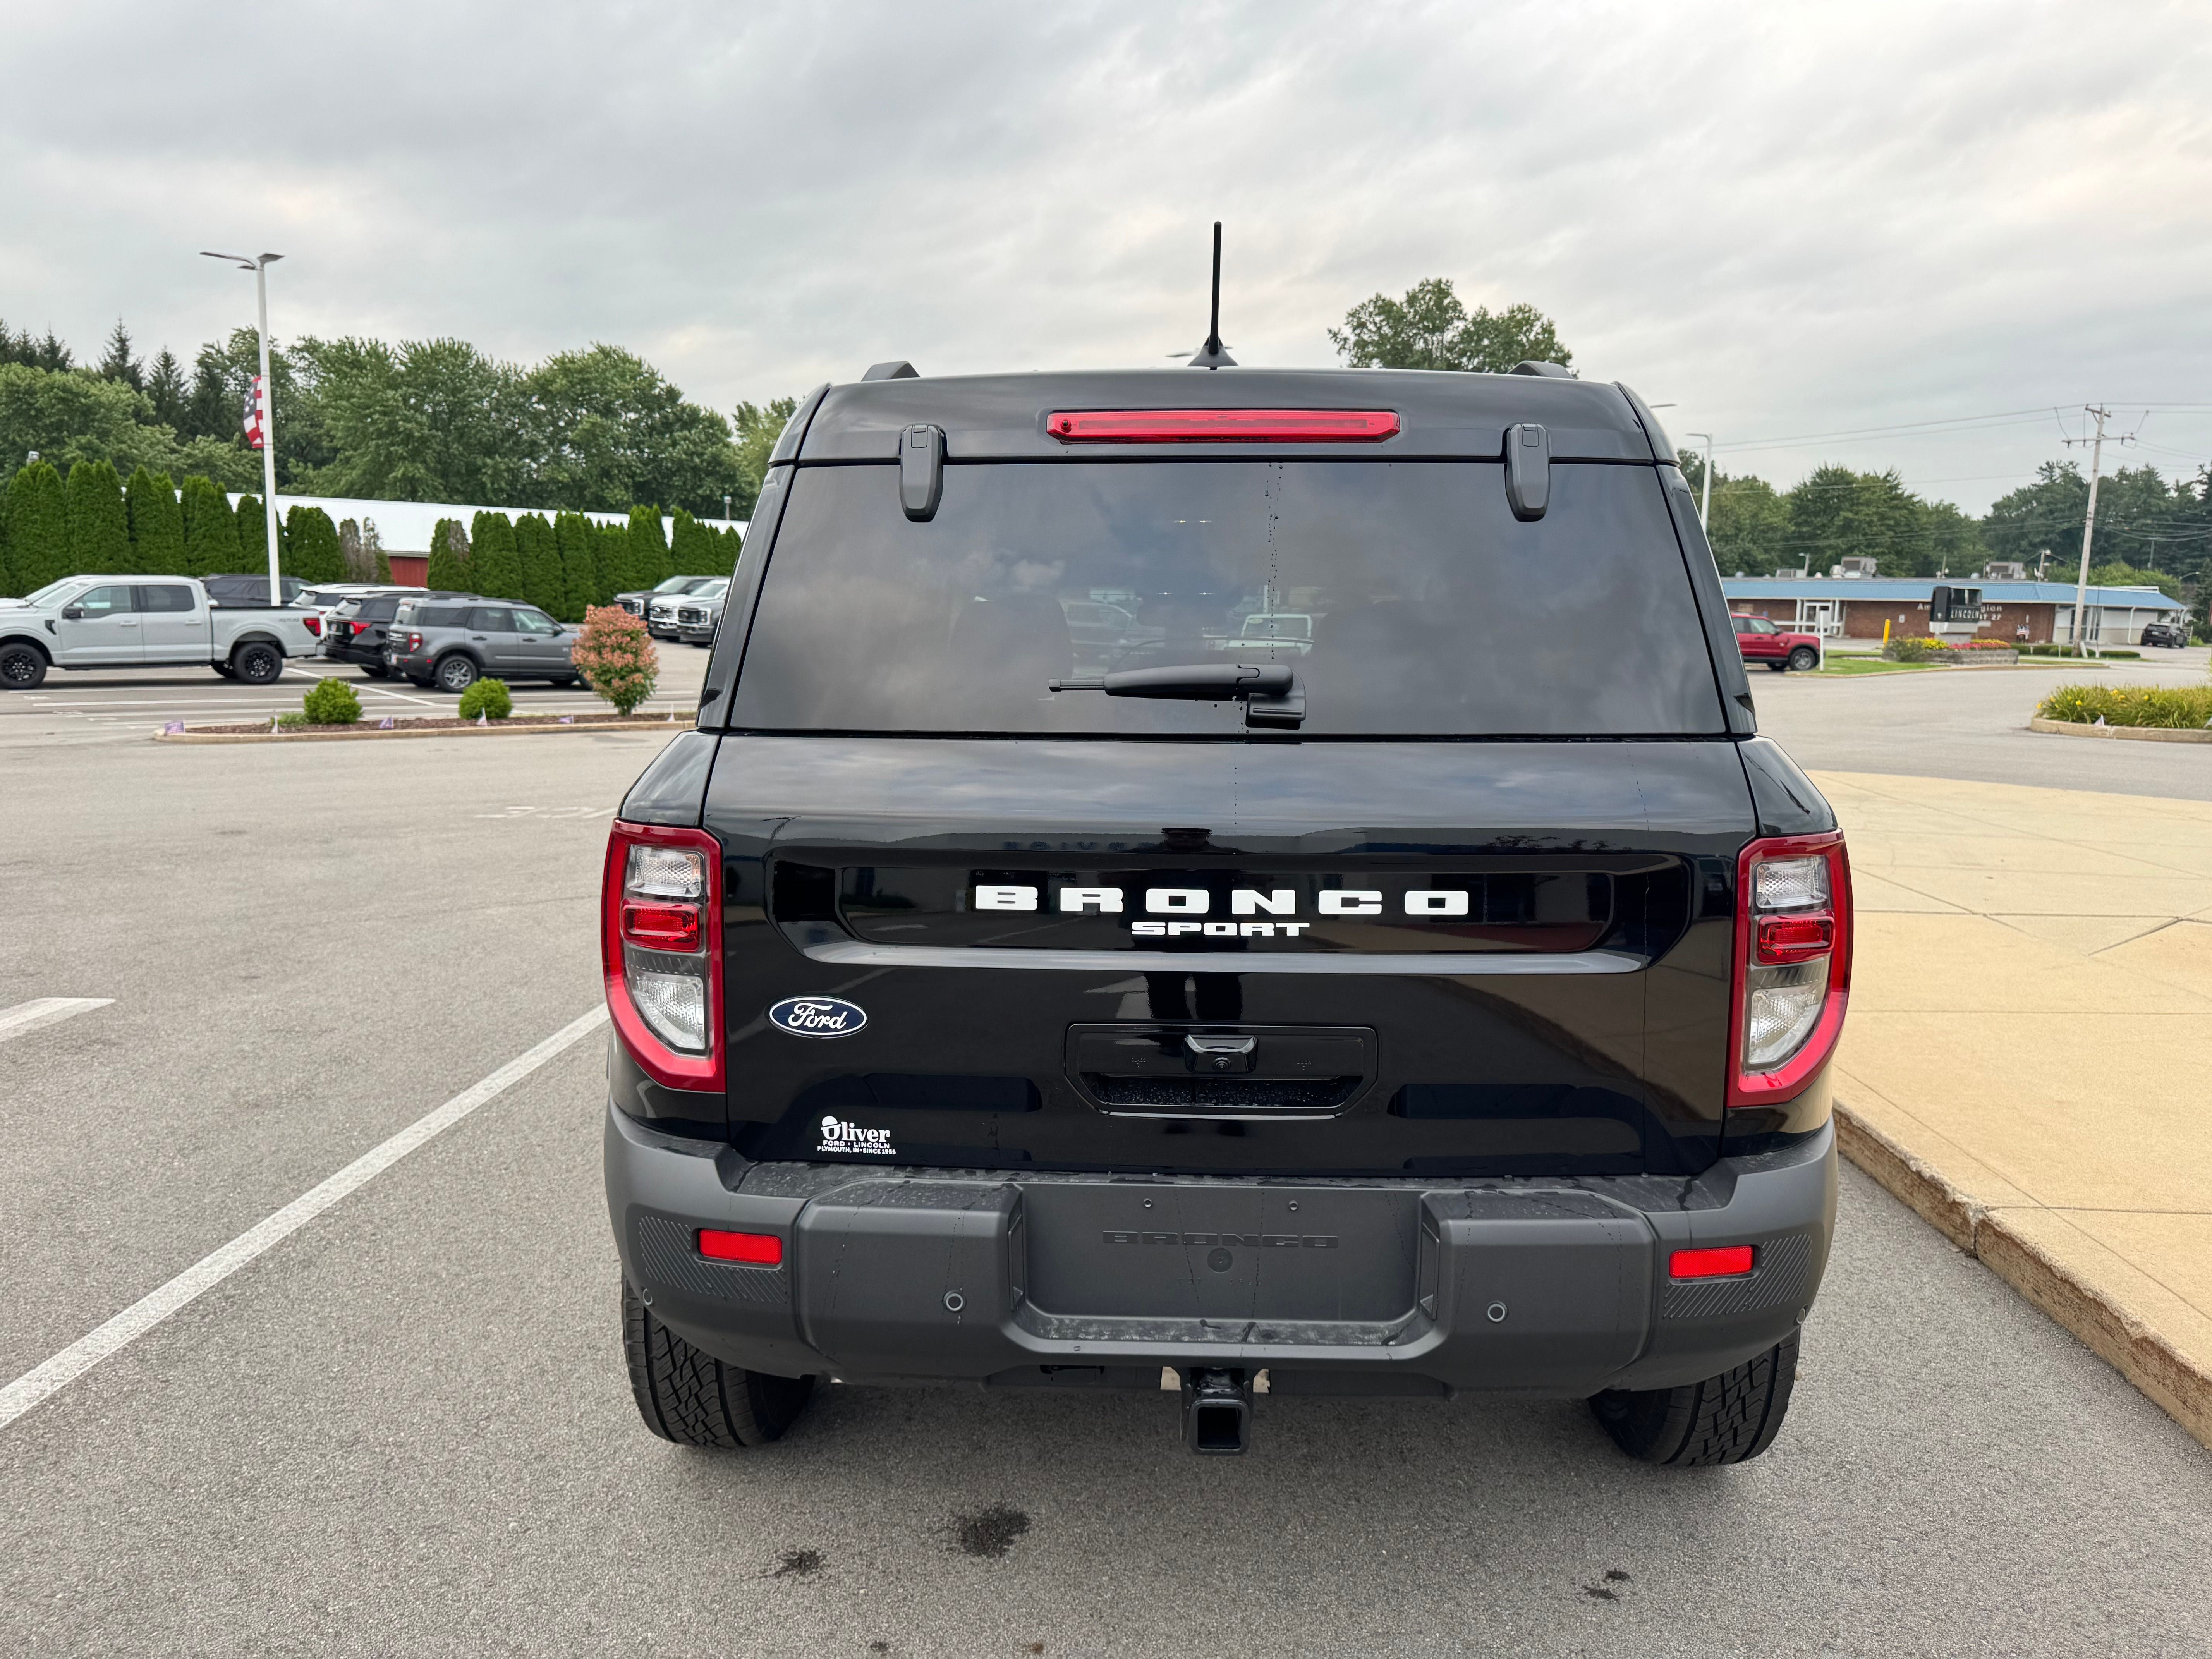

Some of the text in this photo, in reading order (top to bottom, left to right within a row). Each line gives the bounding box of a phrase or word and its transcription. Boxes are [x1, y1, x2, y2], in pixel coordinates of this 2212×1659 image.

[1951, 609, 1979, 618] LINCOLN
[975, 885, 1469, 915] BRONCO
[1131, 922, 1310, 936] SPORT
[788, 1002, 848, 1030] Ford
[821, 1116, 891, 1142] Oliver
[1103, 1230, 1339, 1248] BRONCO
